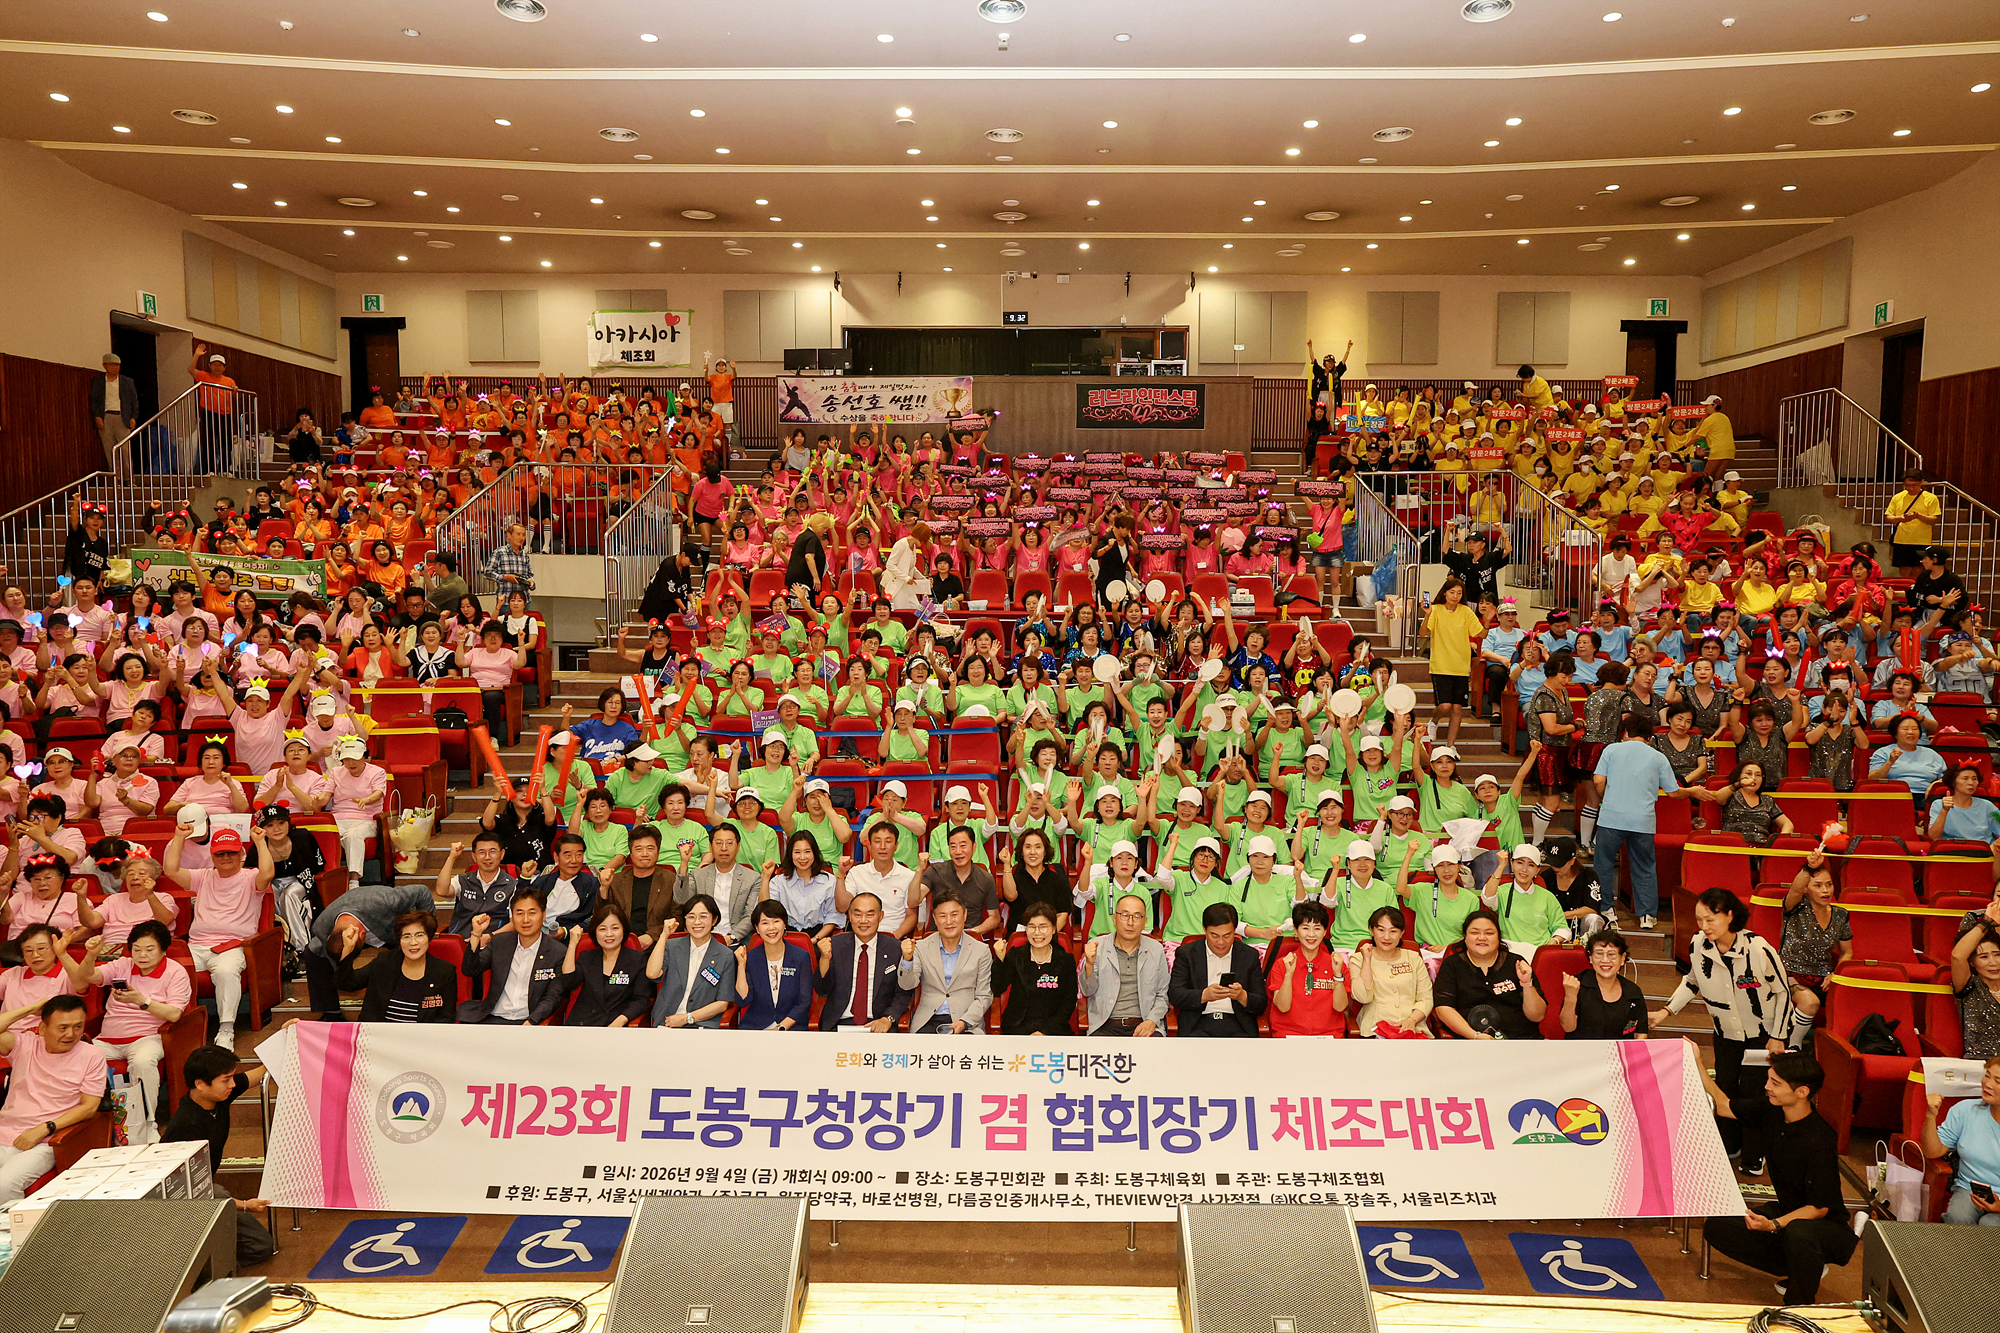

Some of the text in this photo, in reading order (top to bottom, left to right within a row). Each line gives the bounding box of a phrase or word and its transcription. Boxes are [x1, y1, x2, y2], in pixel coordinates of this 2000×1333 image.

[595, 324, 681, 344] 아카시아
[621, 350, 656, 362] 체조회
[821, 394, 927, 413] 송선호 쌤!!
[1088, 388, 1197, 407] 러브라인댄스팀
[840, 414, 867, 422] 수상을
[834, 1052, 1136, 1084] 문화와 경제가 살아 숨 쉬는 도봉대전환
[460, 1083, 1495, 1154] 제23회 도봉구청장기 겸 협회장기 체조대회
[1528, 1134, 1556, 1143] 도봉구
[603, 1166, 636, 1181] 일시:
[640, 1166, 691, 1183] 2026년
[695, 1167, 719, 1184] 9월
[723, 1168, 747, 1184] 4일
[752, 1168, 778, 1185] (금)
[782, 1168, 827, 1185] 개회식
[831, 1170, 873, 1184] 09:00
[915, 1171, 949, 1186] 장소:
[954, 1171, 1046, 1187] 도봉구민회관
[1074, 1172, 1109, 1187] 주최:
[1114, 1172, 1206, 1187] 도봉구체육회
[1236, 1172, 1271, 1187] 주관:
[1277, 1172, 1385, 1187] 도봉구체조협회
[505, 1185, 540, 1201] 후원:
[543, 1186, 592, 1204] 도봉구,
[862, 1192, 942, 1208] 바로선병원,
[948, 1192, 1090, 1209] 다름공인중개사무소,
[1344, 1193, 1397, 1208] 장솔주,
[1402, 1191, 1497, 1207] 서울리즈치과
